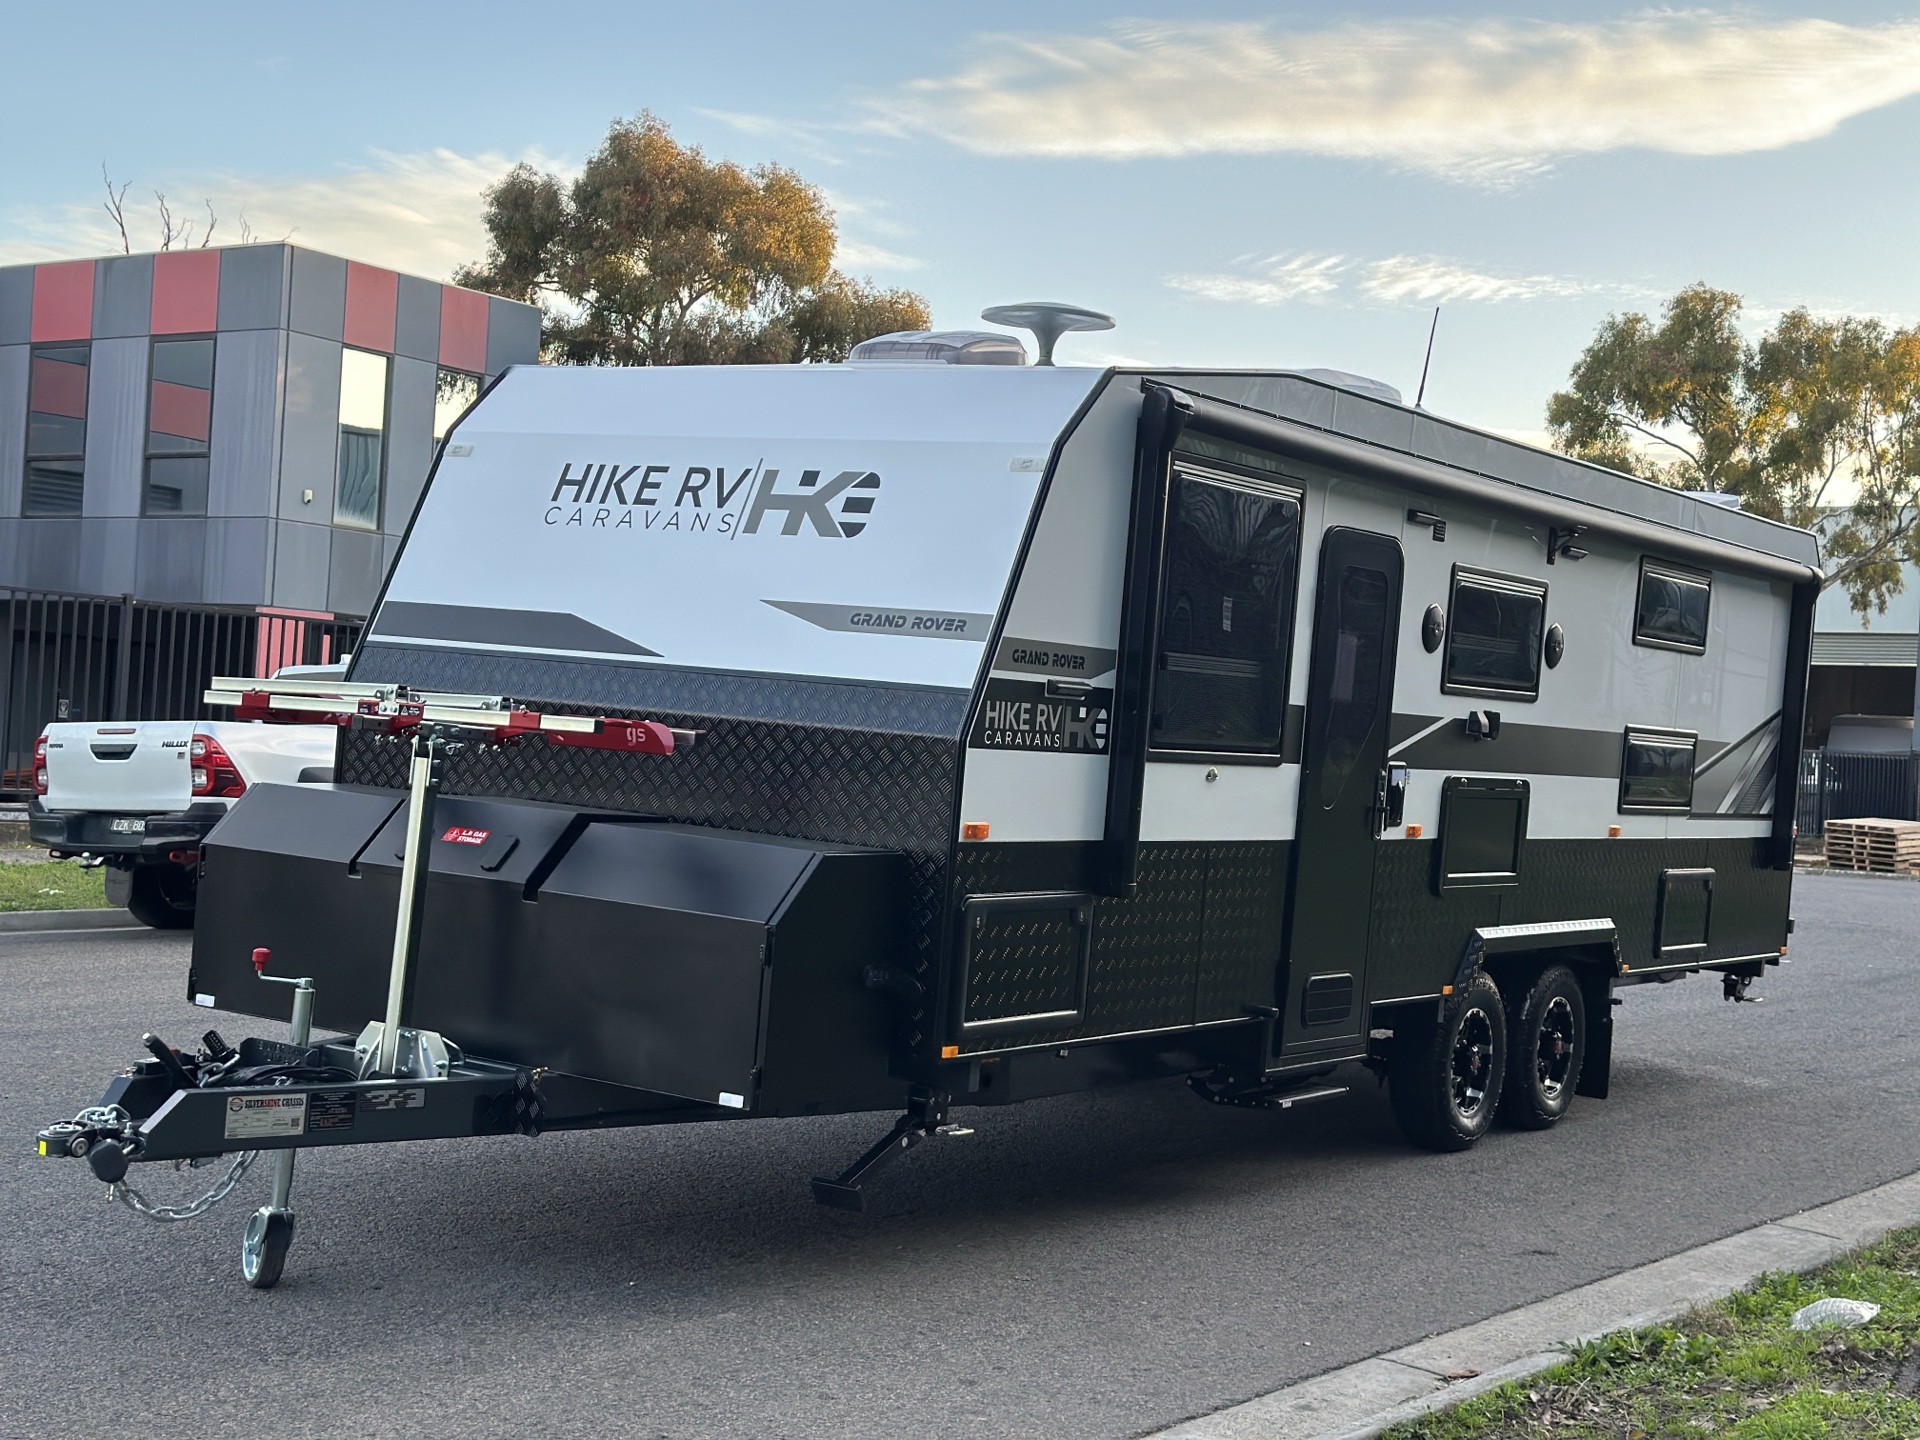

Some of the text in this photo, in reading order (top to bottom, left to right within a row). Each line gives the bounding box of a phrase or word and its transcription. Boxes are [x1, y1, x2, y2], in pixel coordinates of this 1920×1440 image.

[550, 462, 753, 509] HIKE RV
[544, 506, 735, 533] CARAVANS
[850, 612, 968, 632] GRAND ROVER
[1012, 649, 1086, 670] GRAND ROVER
[985, 700, 1063, 732] HIKE RV
[162, 740, 189, 748] HILUX
[984, 730, 1061, 748] CARAVANS
